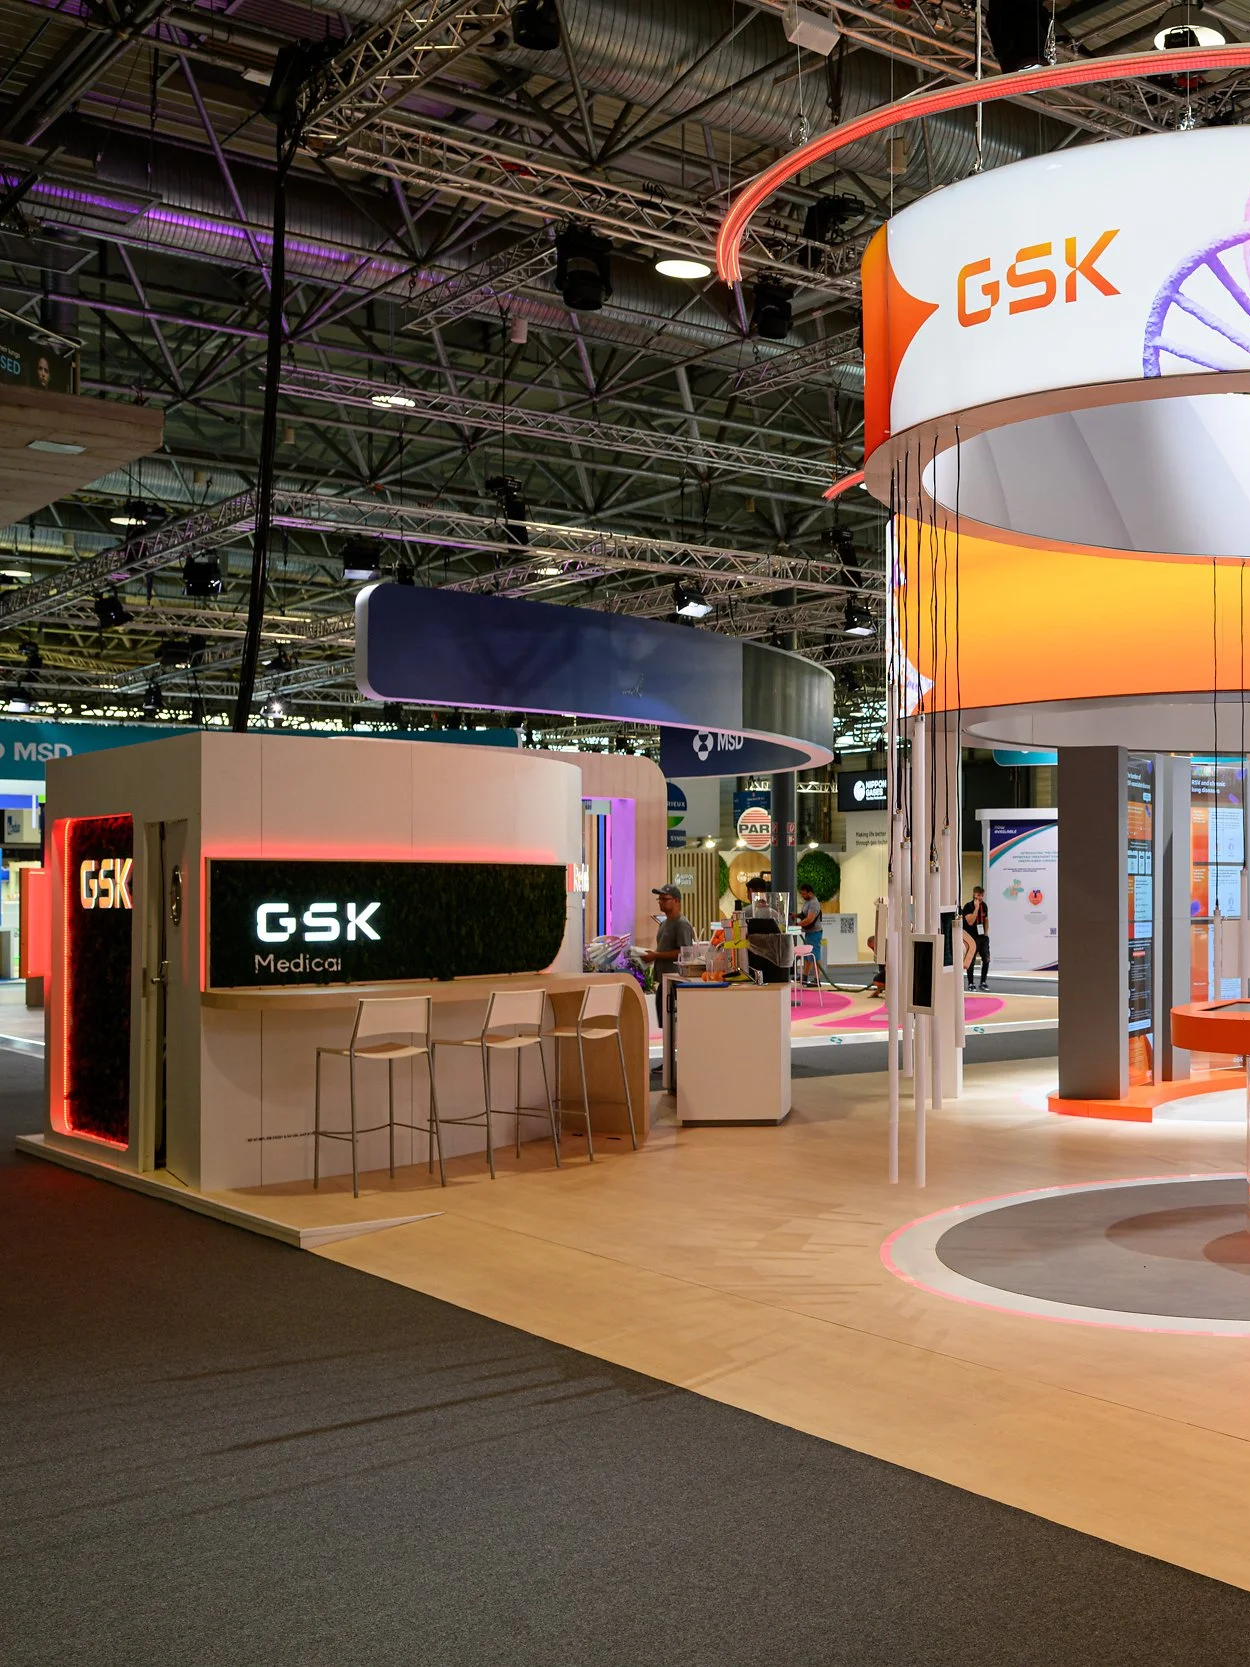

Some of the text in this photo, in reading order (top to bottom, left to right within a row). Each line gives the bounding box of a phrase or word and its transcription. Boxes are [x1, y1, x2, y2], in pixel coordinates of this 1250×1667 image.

[957, 229, 1121, 328] GSK
[14, 742, 73, 762] MSD
[718, 733, 744, 751] MSD
[866, 780, 887, 788] NIPPON
[738, 824, 770, 834] PAR
[79, 857, 133, 910] GSK
[255, 902, 382, 943] GSK
